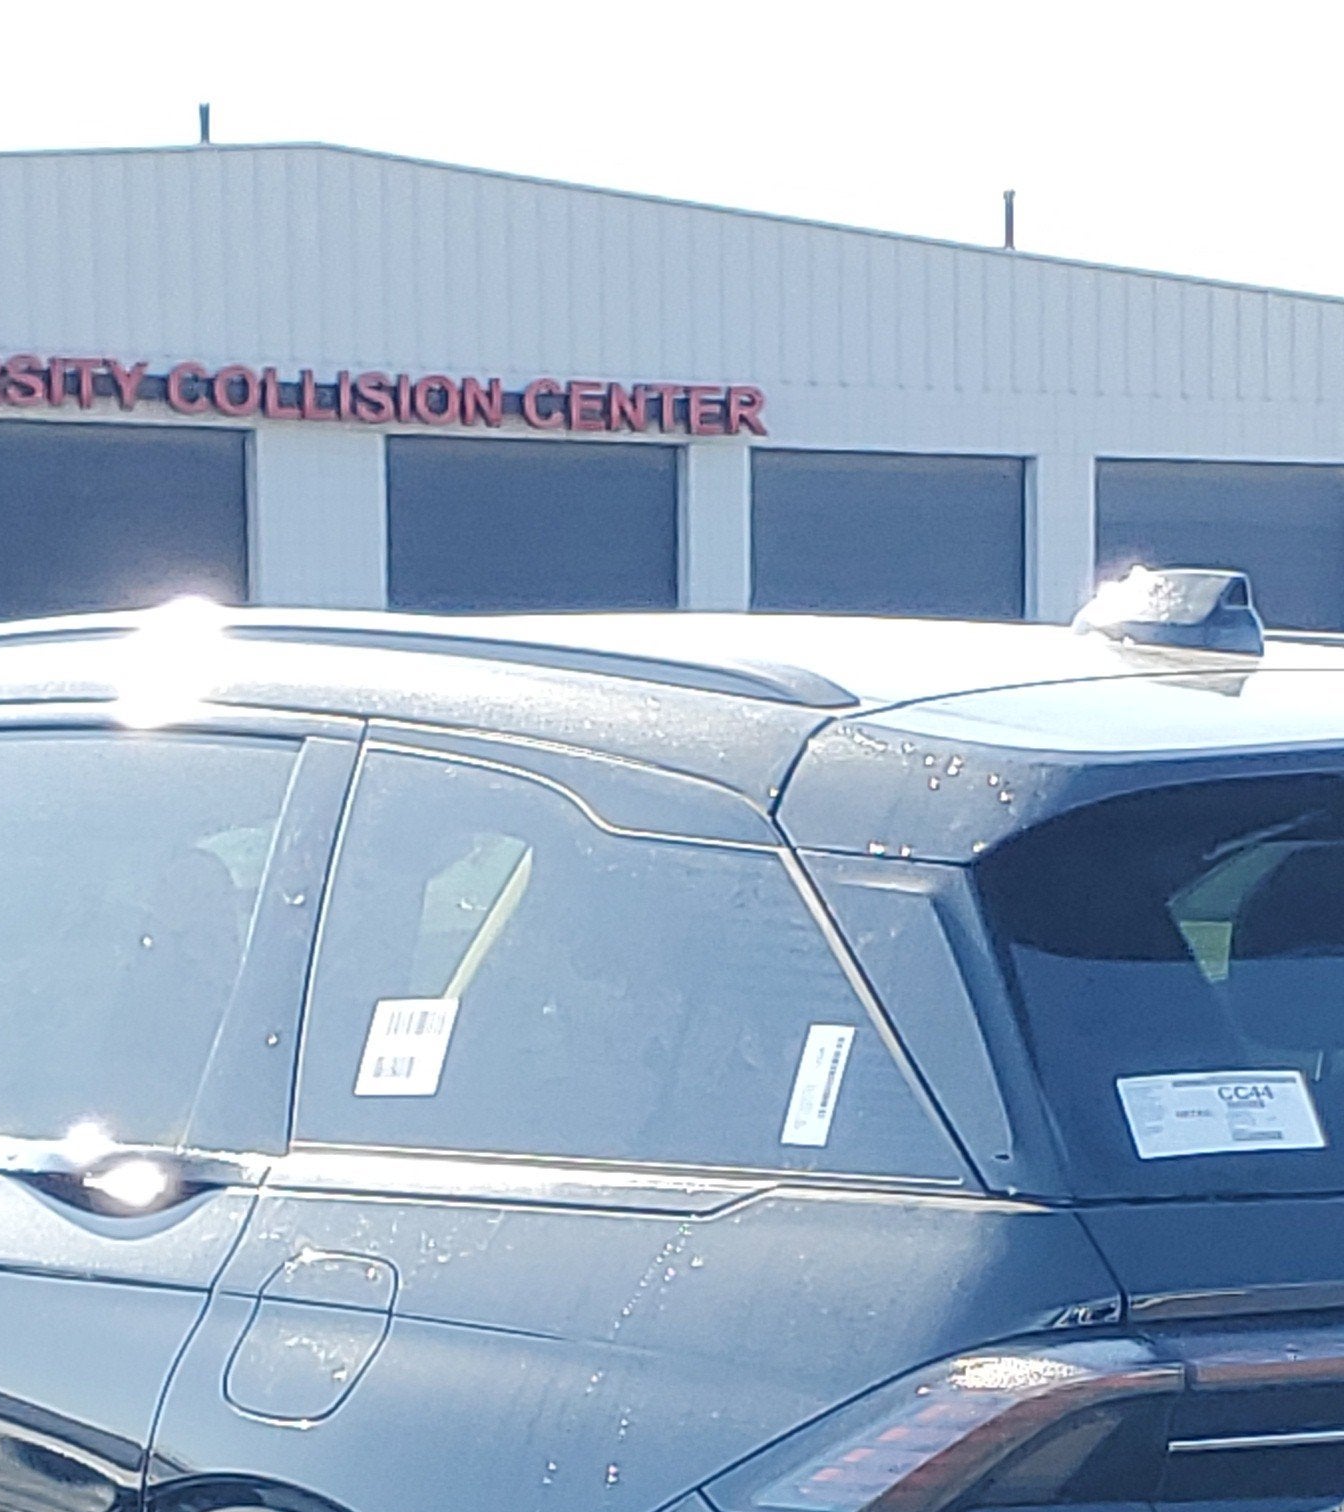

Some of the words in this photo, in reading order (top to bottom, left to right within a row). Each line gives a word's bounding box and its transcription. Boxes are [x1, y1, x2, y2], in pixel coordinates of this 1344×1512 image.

[166, 360, 502, 428] COLLISION
[523, 377, 768, 436] CENTER
[1217, 1084, 1275, 1101] CC44
